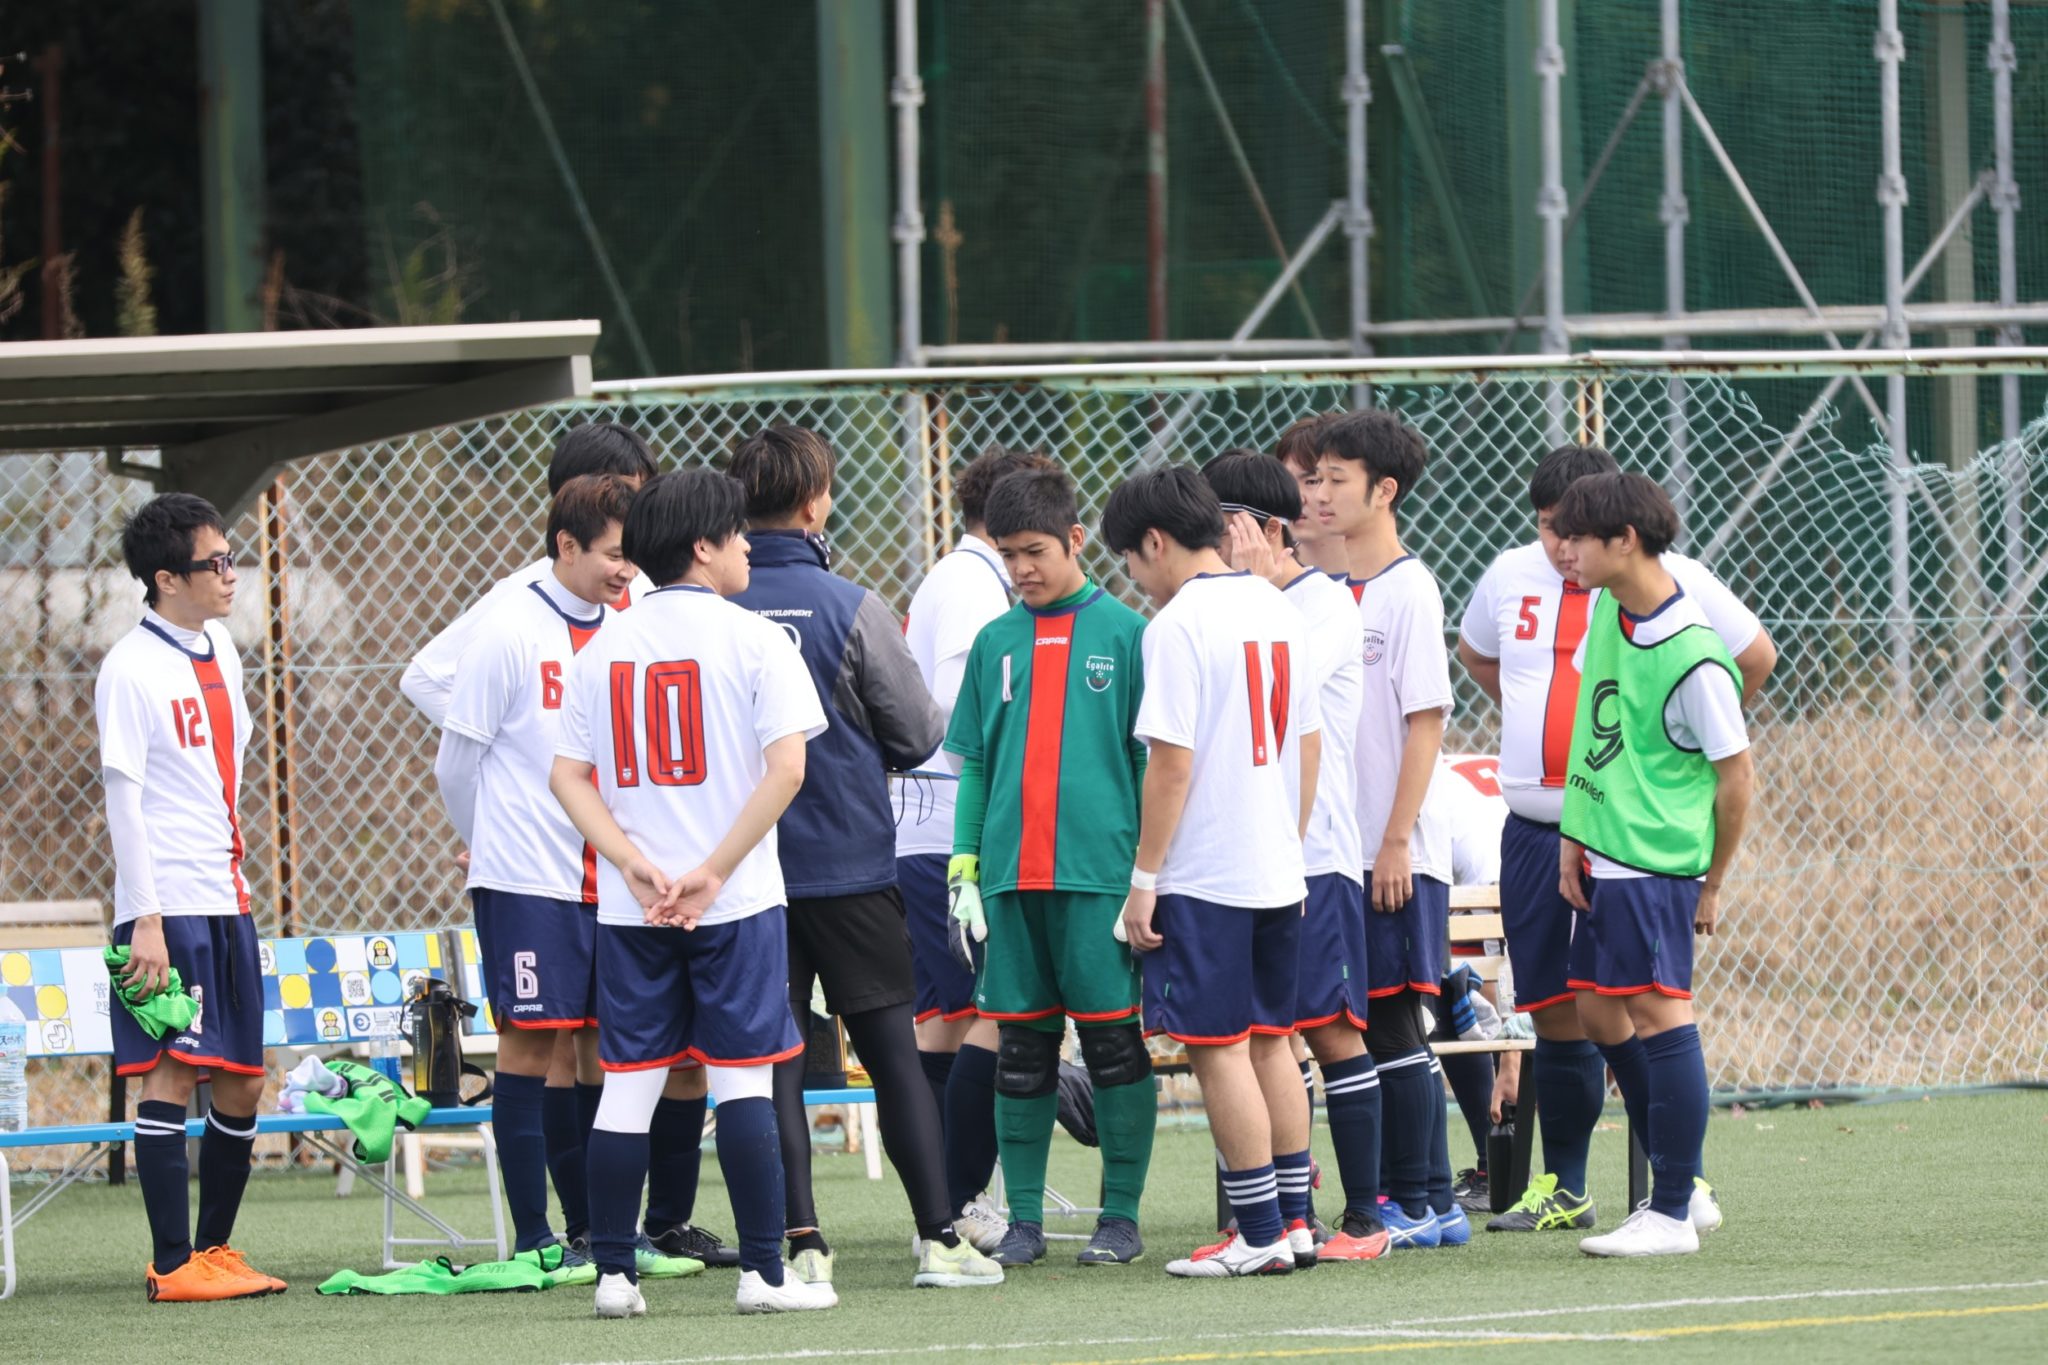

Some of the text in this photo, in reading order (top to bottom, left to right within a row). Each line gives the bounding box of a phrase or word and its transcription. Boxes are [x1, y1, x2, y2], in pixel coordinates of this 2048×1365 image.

[760, 609, 813, 617] DEVELOPMENT
[1515, 596, 1541, 640] 5
[540, 660, 564, 710] 6
[1002, 655, 1012, 703] 1
[171, 697, 206, 749] 12
[609, 659, 707, 788] 10
[513, 951, 539, 999] 6
